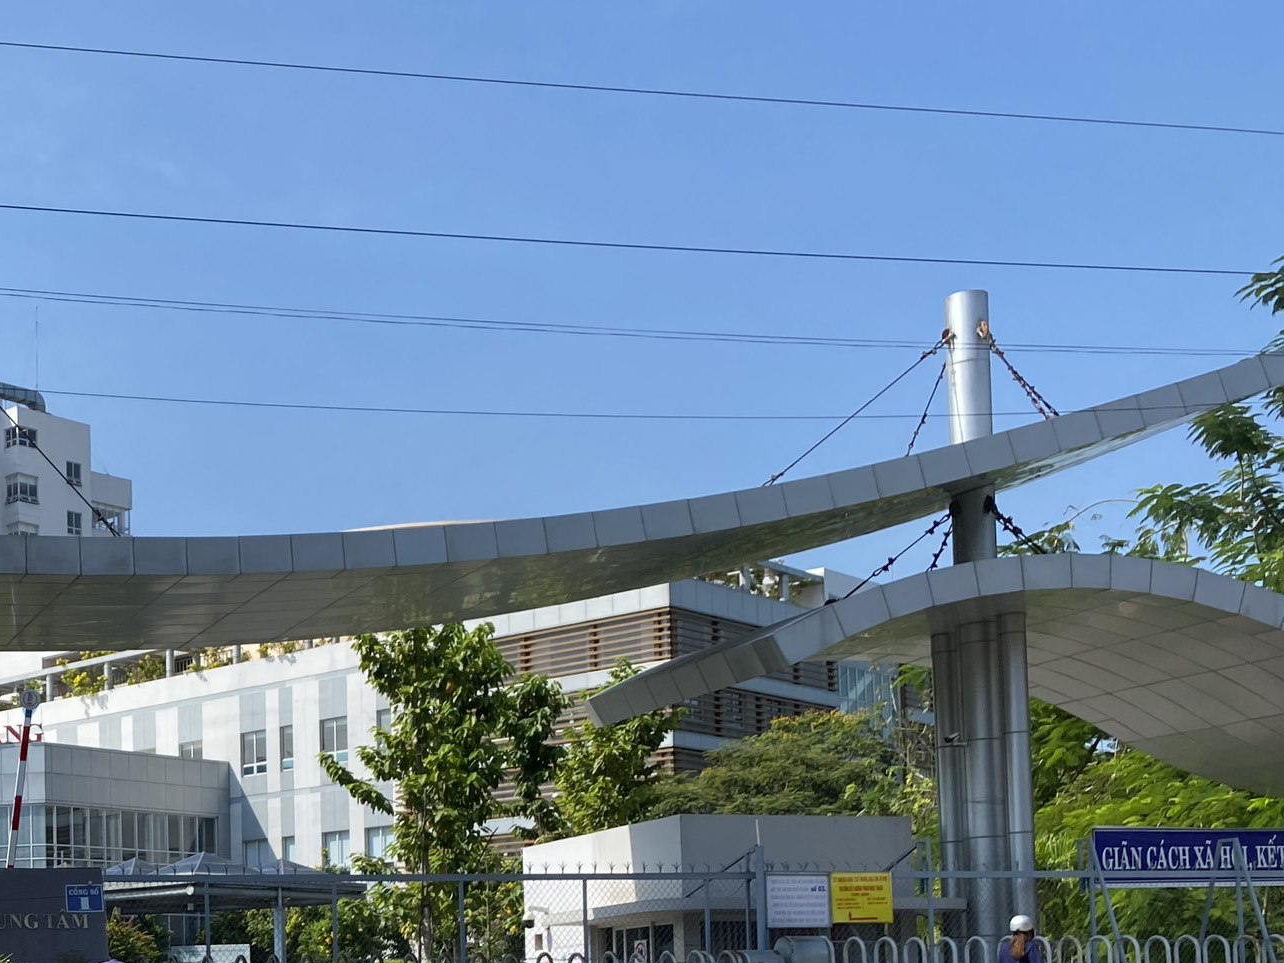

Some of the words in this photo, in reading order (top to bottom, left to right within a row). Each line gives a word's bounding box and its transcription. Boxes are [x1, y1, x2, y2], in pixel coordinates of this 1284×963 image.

[1102, 841, 1142, 870] GIÃN
[1146, 839, 1190, 870] CÁCH
[1193, 840, 1214, 869] XÃ
[1220, 845, 1252, 871] HI,
[77, 896, 93, 910] 1
[43, 908, 89, 929] TÂM
